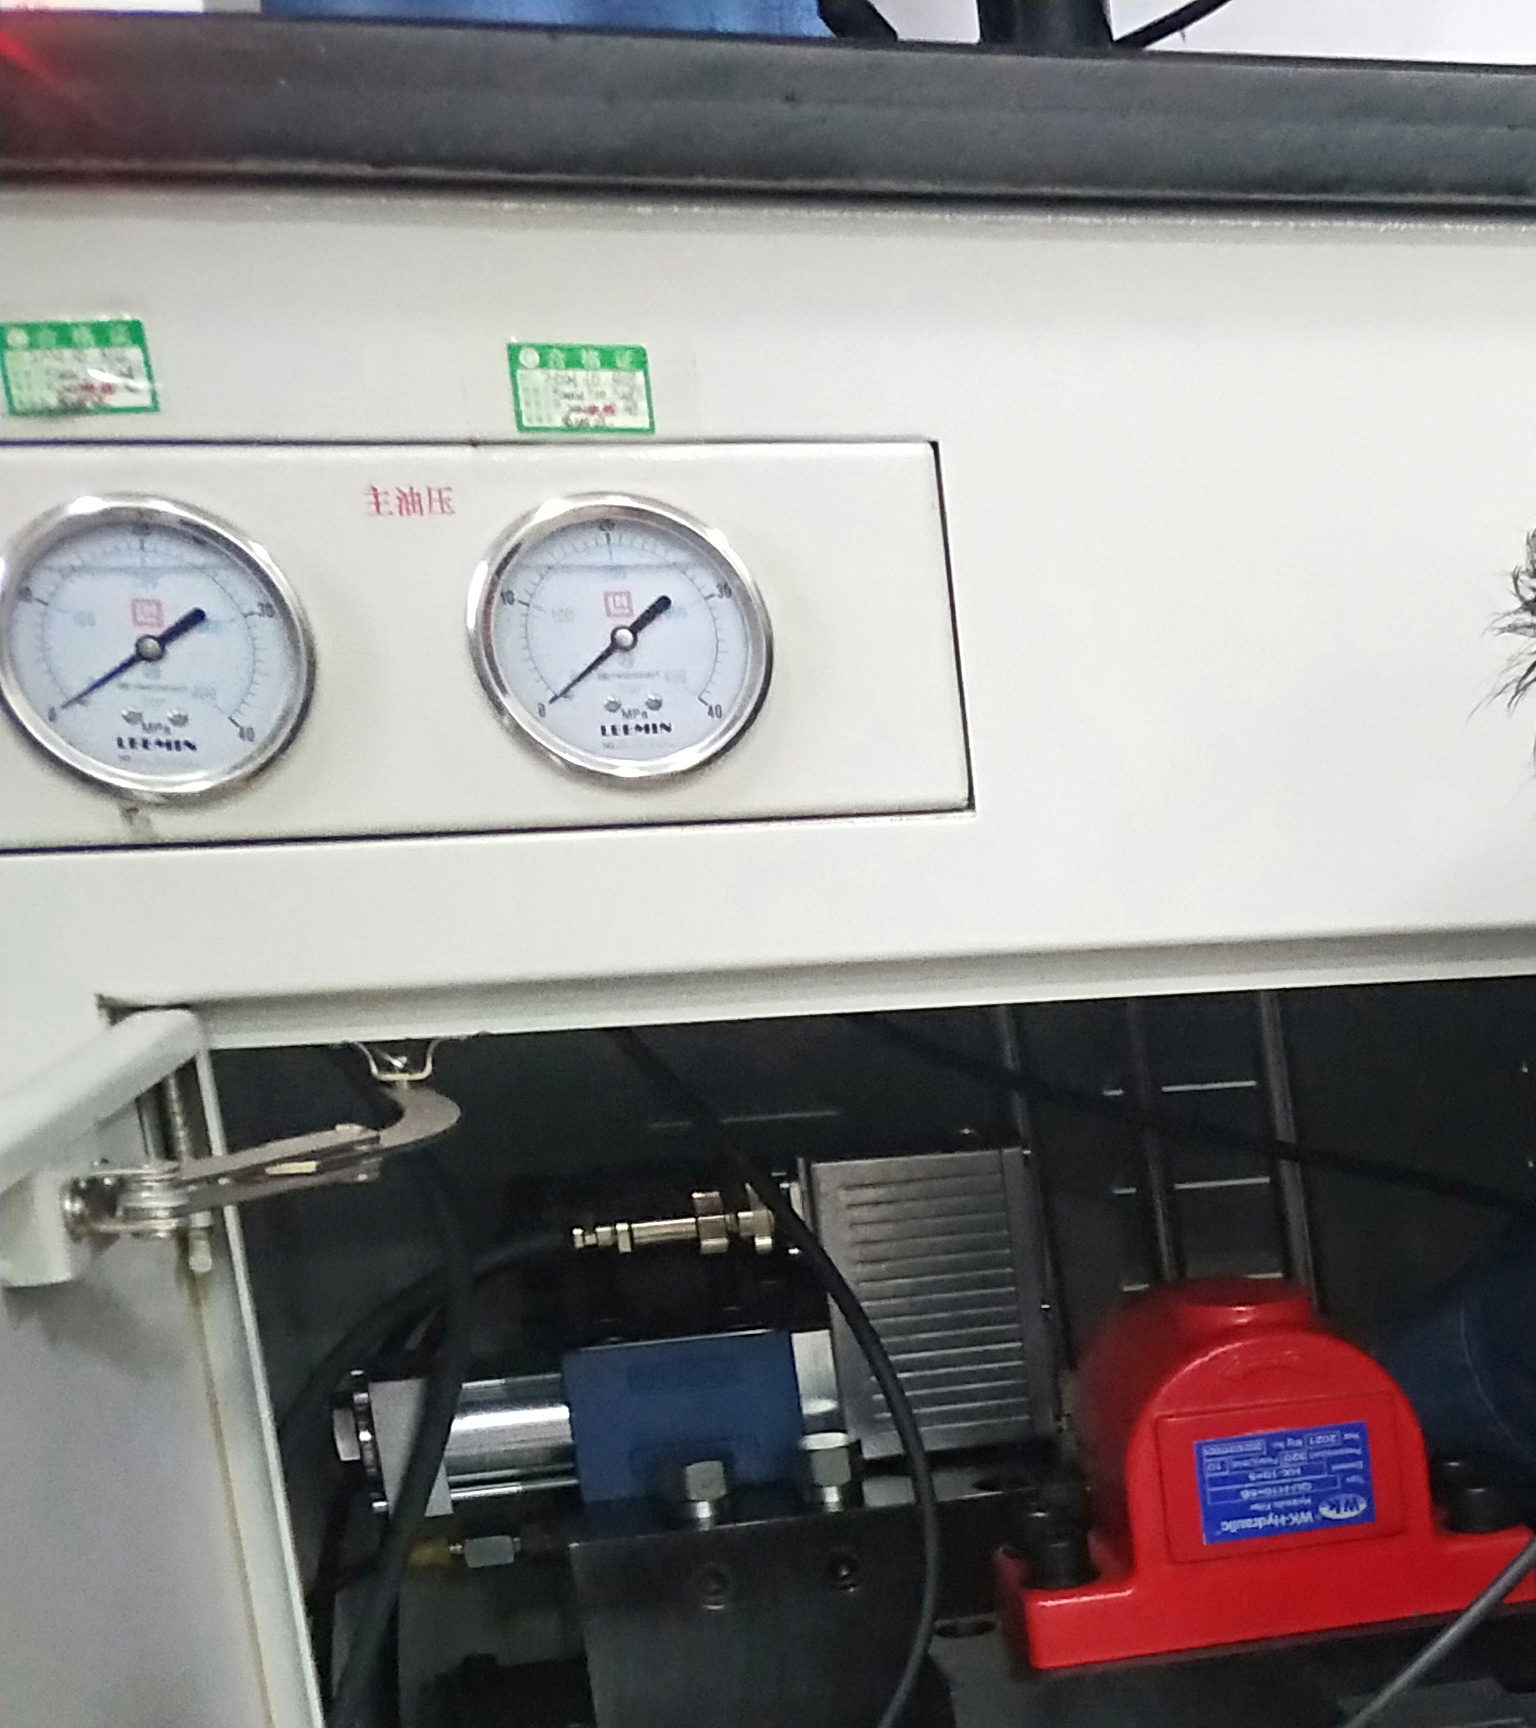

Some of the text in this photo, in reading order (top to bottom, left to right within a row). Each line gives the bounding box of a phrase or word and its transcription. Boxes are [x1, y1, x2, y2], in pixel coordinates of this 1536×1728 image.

[364, 485, 455, 516] 主油压
[538, 703, 546, 718] 0
[621, 708, 648, 719] MPa
[707, 704, 722, 719] 40
